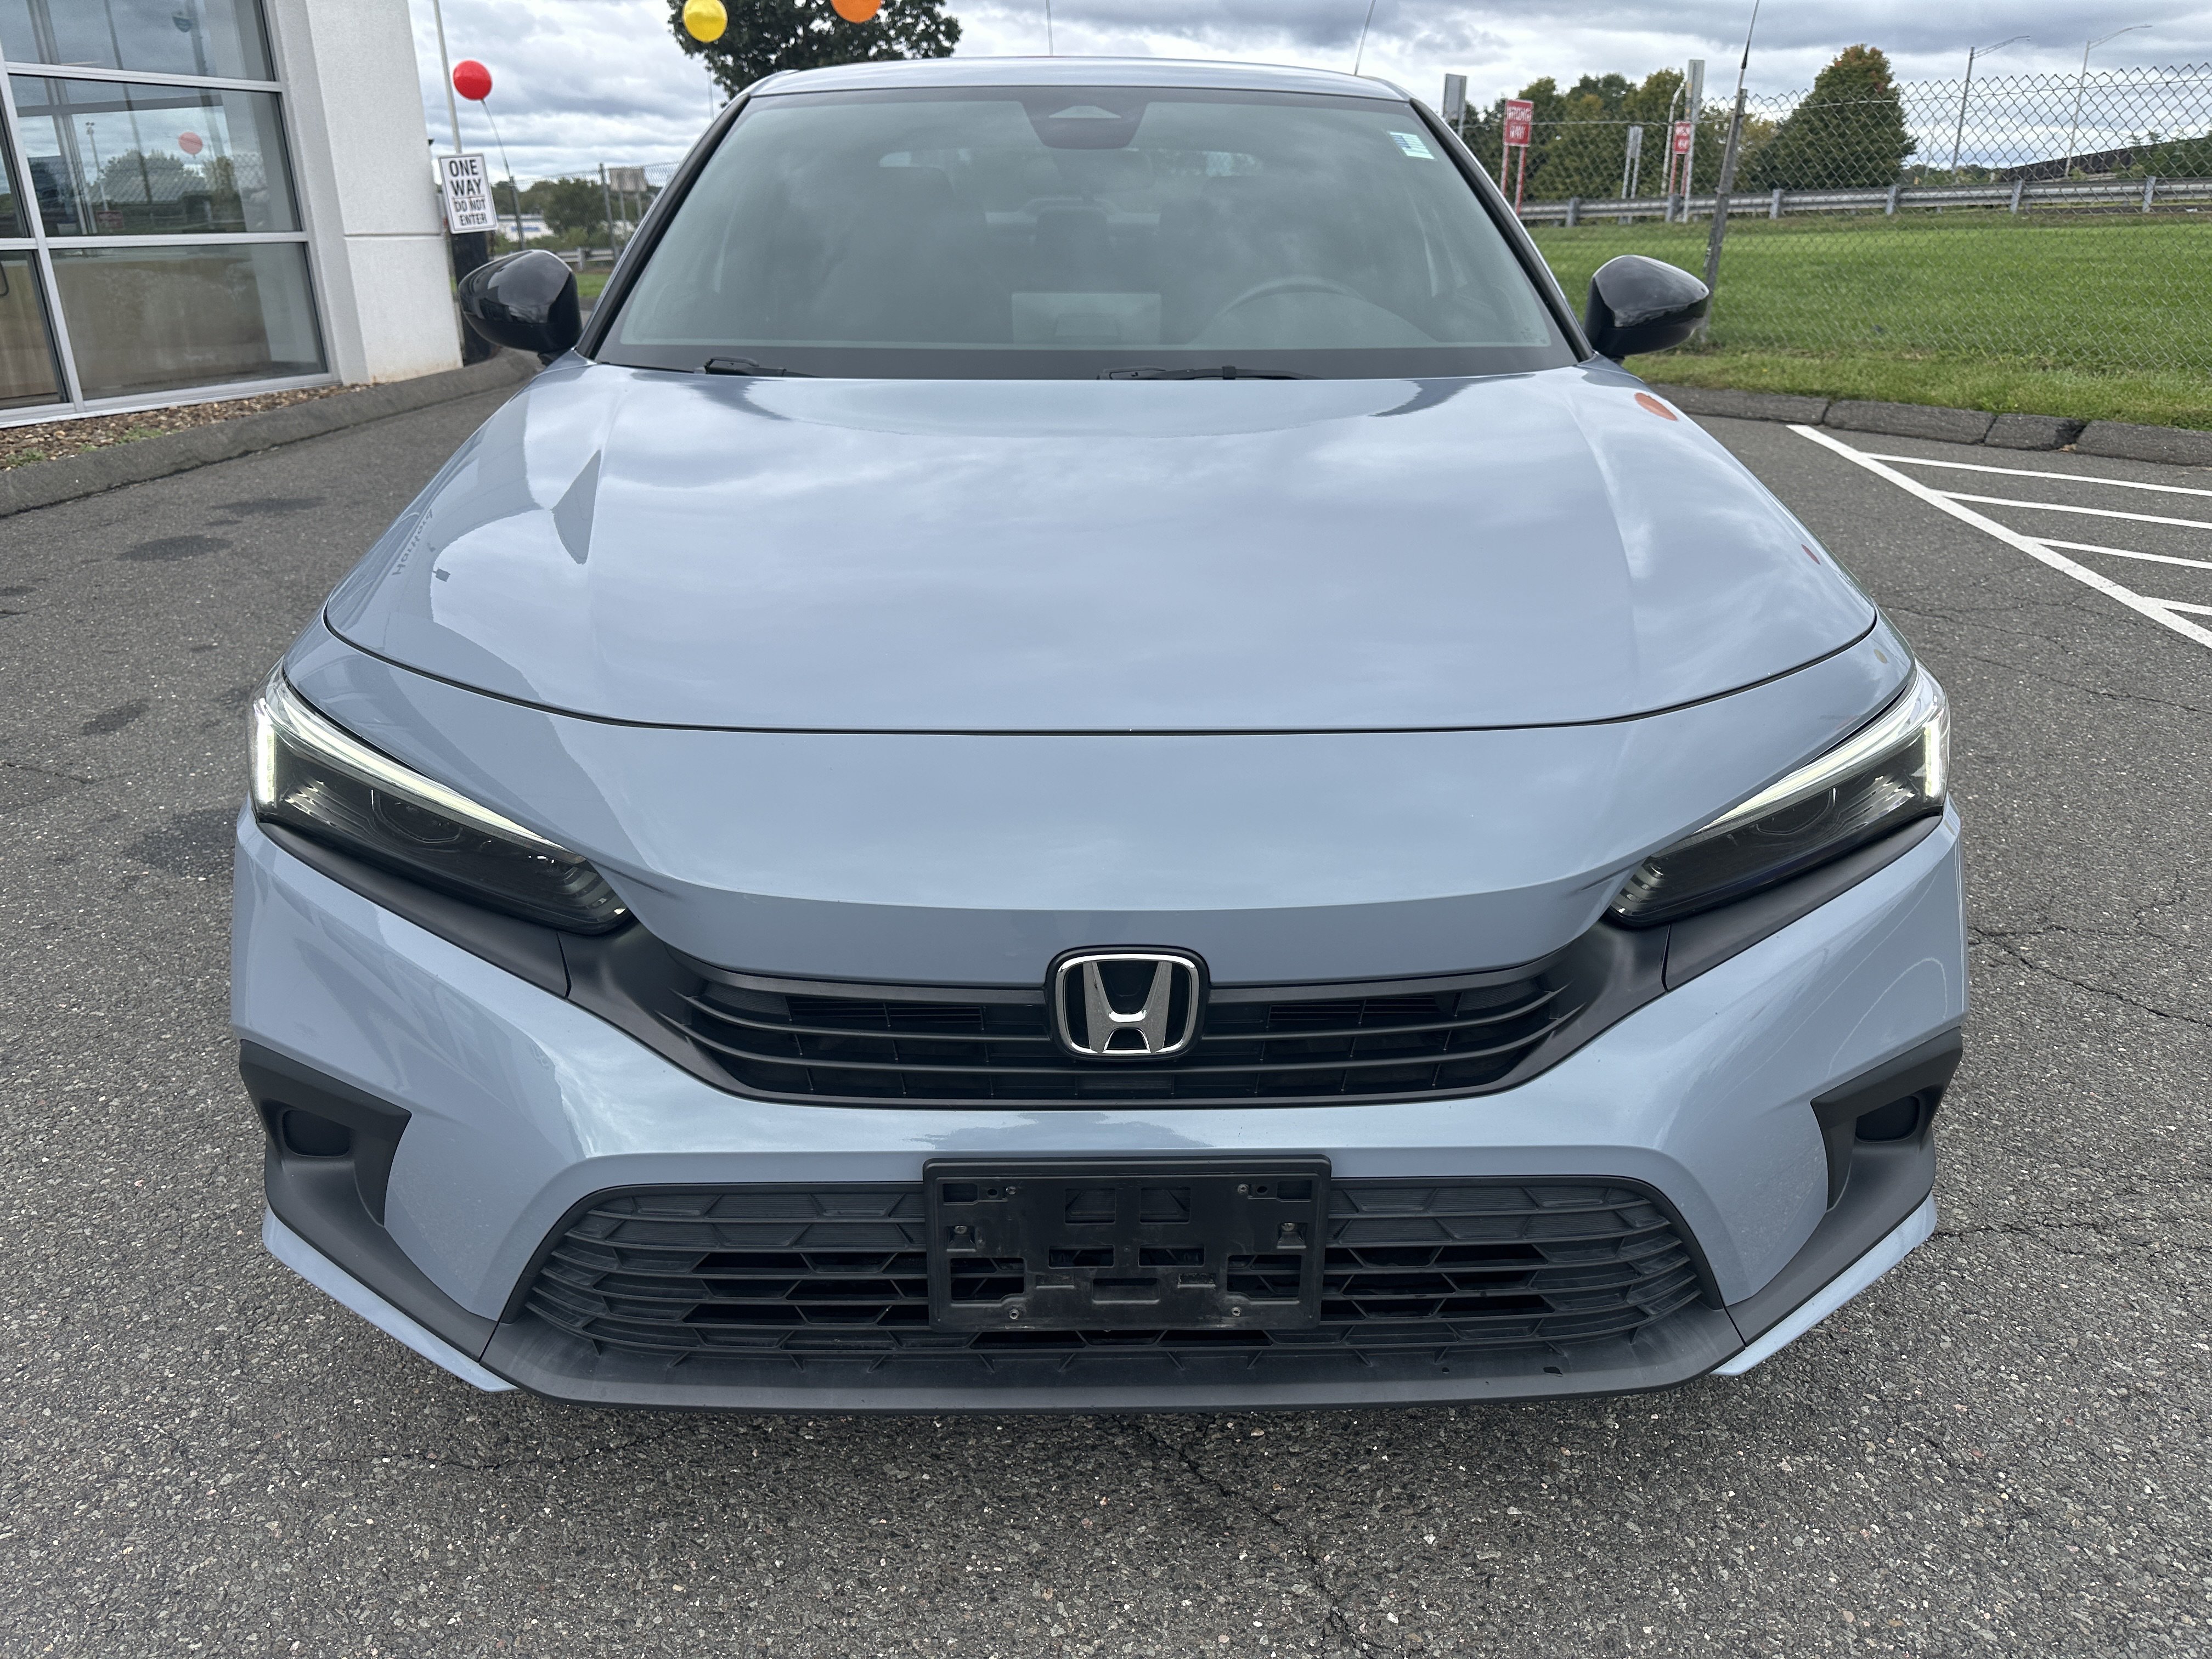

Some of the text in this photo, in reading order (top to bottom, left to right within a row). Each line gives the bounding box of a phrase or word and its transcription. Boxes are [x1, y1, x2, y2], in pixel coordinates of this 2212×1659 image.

[449, 160, 478, 177] ONE
[450, 179, 481, 196] WAY
[454, 198, 486, 212] DO NOT
[460, 213, 488, 226] ENTER
